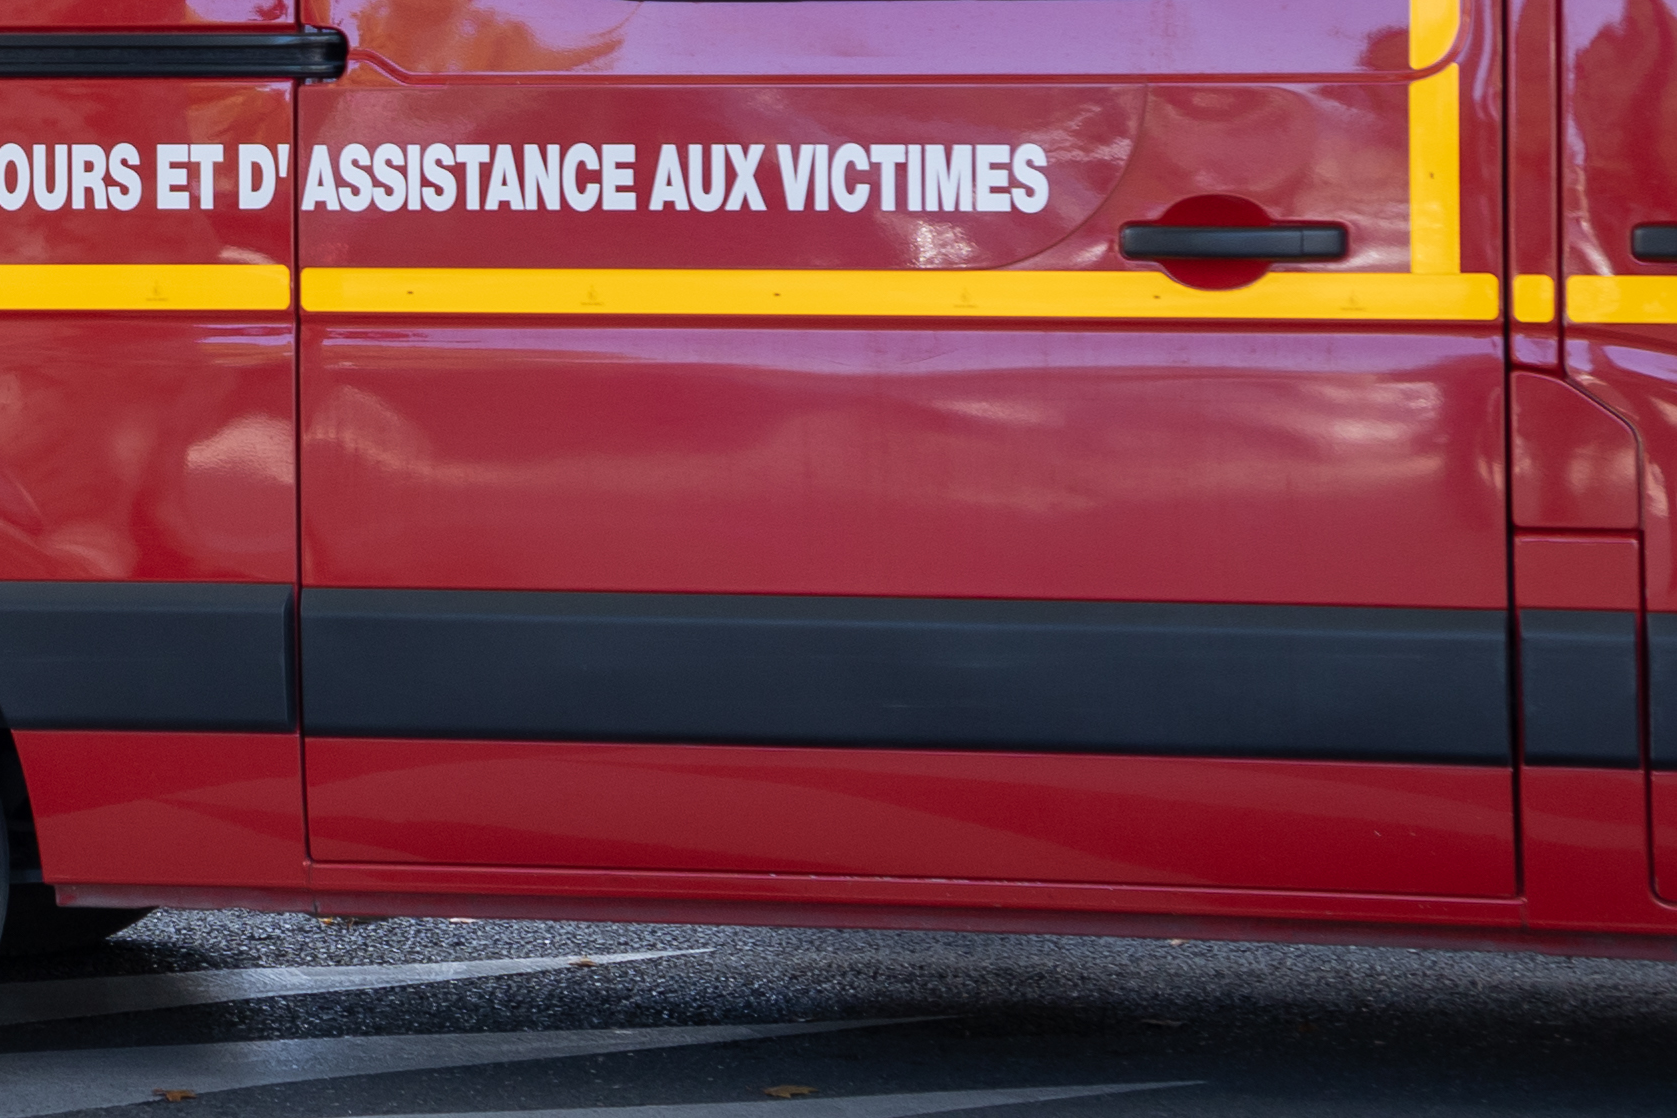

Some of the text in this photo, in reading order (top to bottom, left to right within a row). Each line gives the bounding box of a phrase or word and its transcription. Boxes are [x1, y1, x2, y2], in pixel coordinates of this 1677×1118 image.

[156, 144, 224, 210] ET
[649, 144, 767, 211] AUX
[776, 143, 1049, 213] VICTIMES
